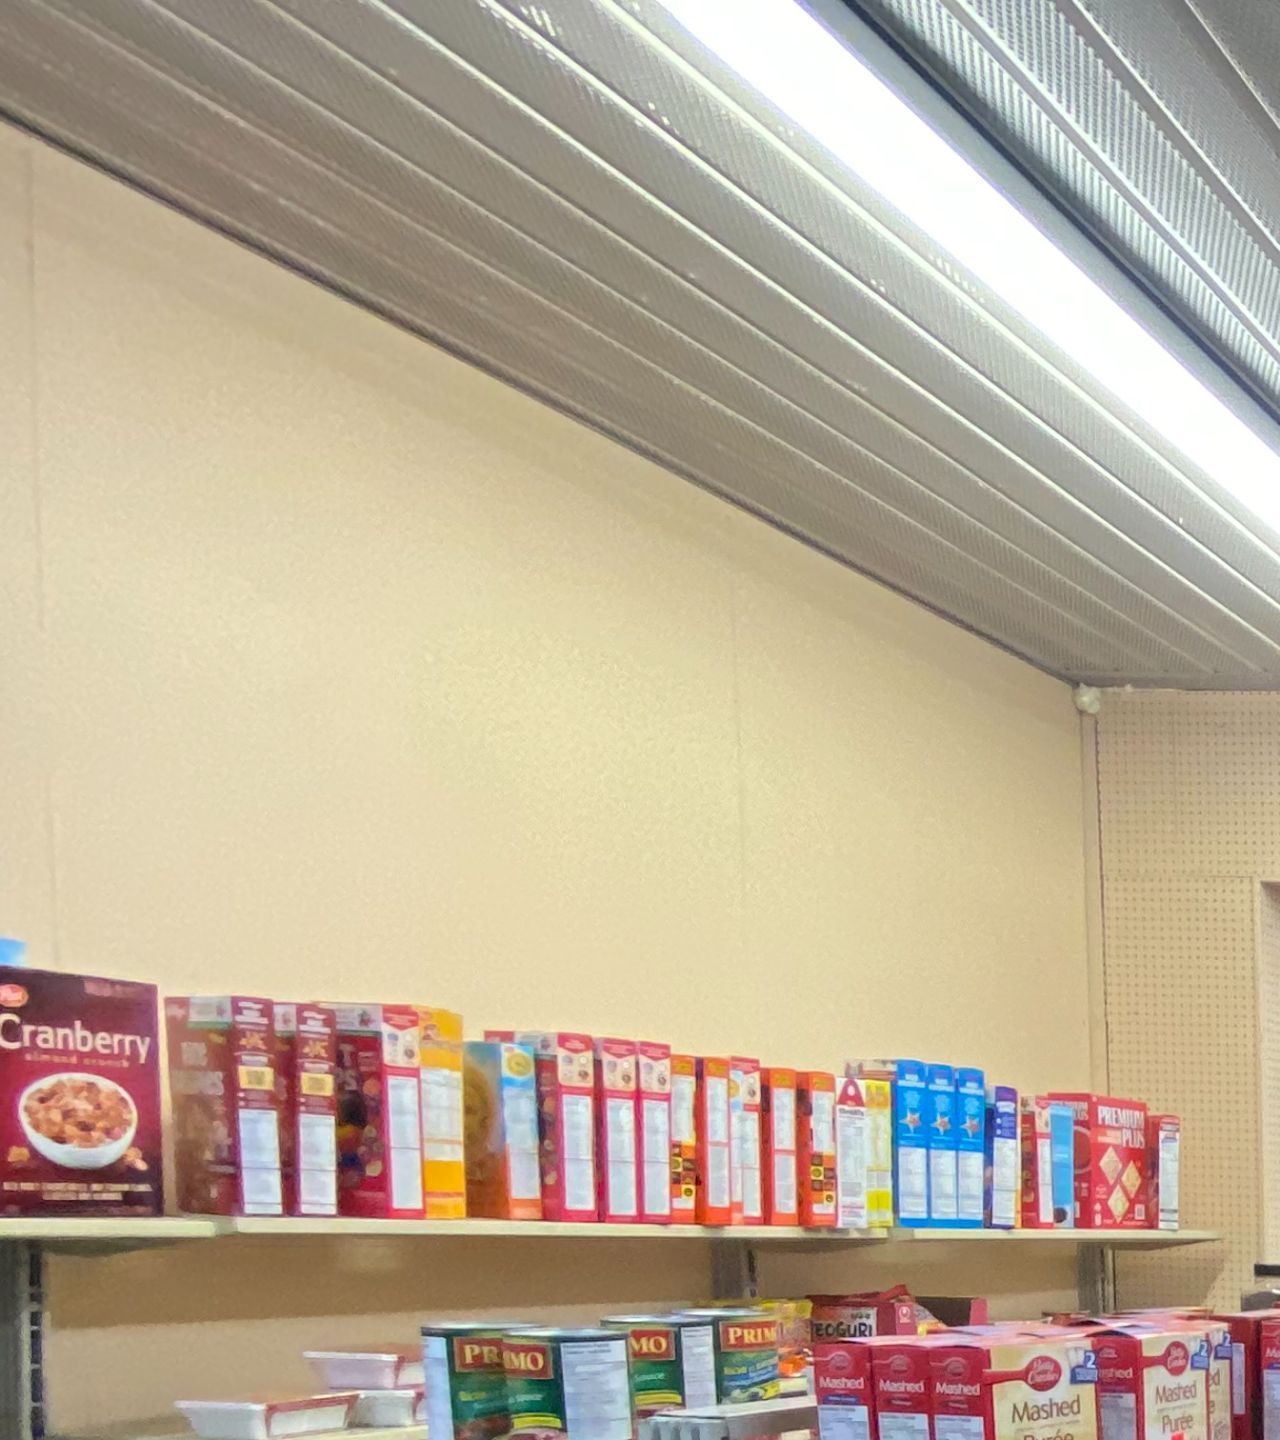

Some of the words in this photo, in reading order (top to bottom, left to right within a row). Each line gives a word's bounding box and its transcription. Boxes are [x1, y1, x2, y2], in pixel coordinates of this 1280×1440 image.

[0, 1013, 150, 1064] Cranberry
[1098, 1105, 1145, 1129] PREMIUM
[1122, 1128, 1145, 1149] PLUS
[727, 1326, 777, 1345] PRIM
[814, 1320, 873, 1338] EOGURI
[1086, 1352, 1096, 1368] 2
[819, 1376, 864, 1389] Mashed
[879, 1379, 924, 1393] Mashed
[935, 1382, 981, 1396] Mashed
[1155, 1380, 1197, 1404] Mashed
[1011, 1394, 1081, 1424] Mashed
